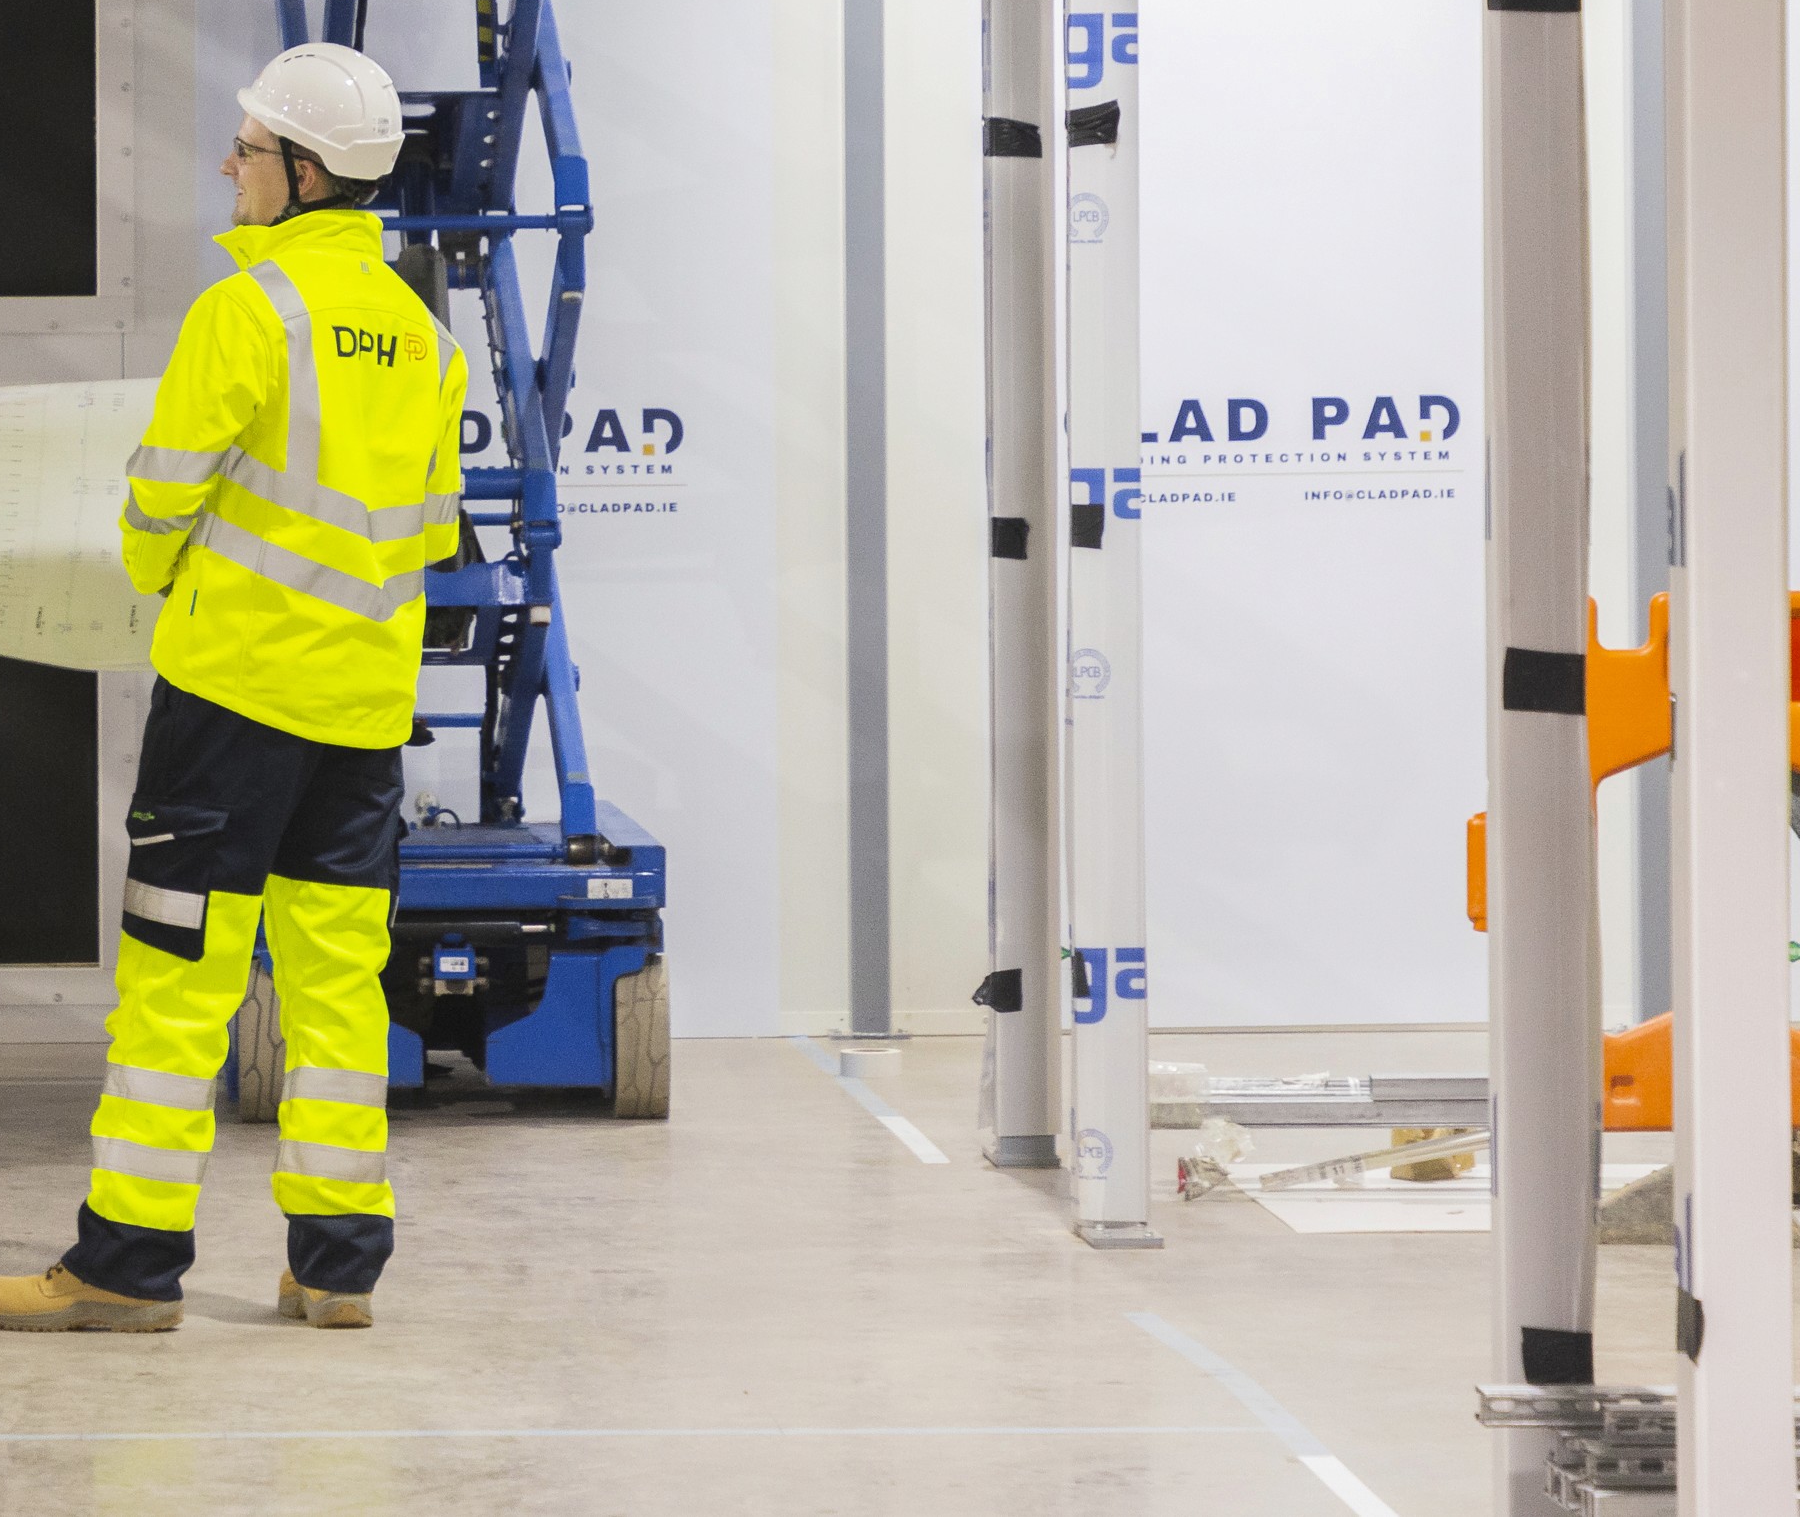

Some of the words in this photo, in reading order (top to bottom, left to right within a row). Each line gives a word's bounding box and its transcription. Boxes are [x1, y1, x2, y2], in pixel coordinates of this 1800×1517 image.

[1073, 210, 1100, 223] LPCB
[331, 325, 397, 368] DPH
[1312, 394, 1461, 442] PAD
[1203, 451, 1348, 464] PROTECTION
[1363, 450, 1450, 461] SYSTEM
[586, 464, 673, 475] SYSTEM
[1304, 488, 1456, 501] INFO@CLADPAD.IE
